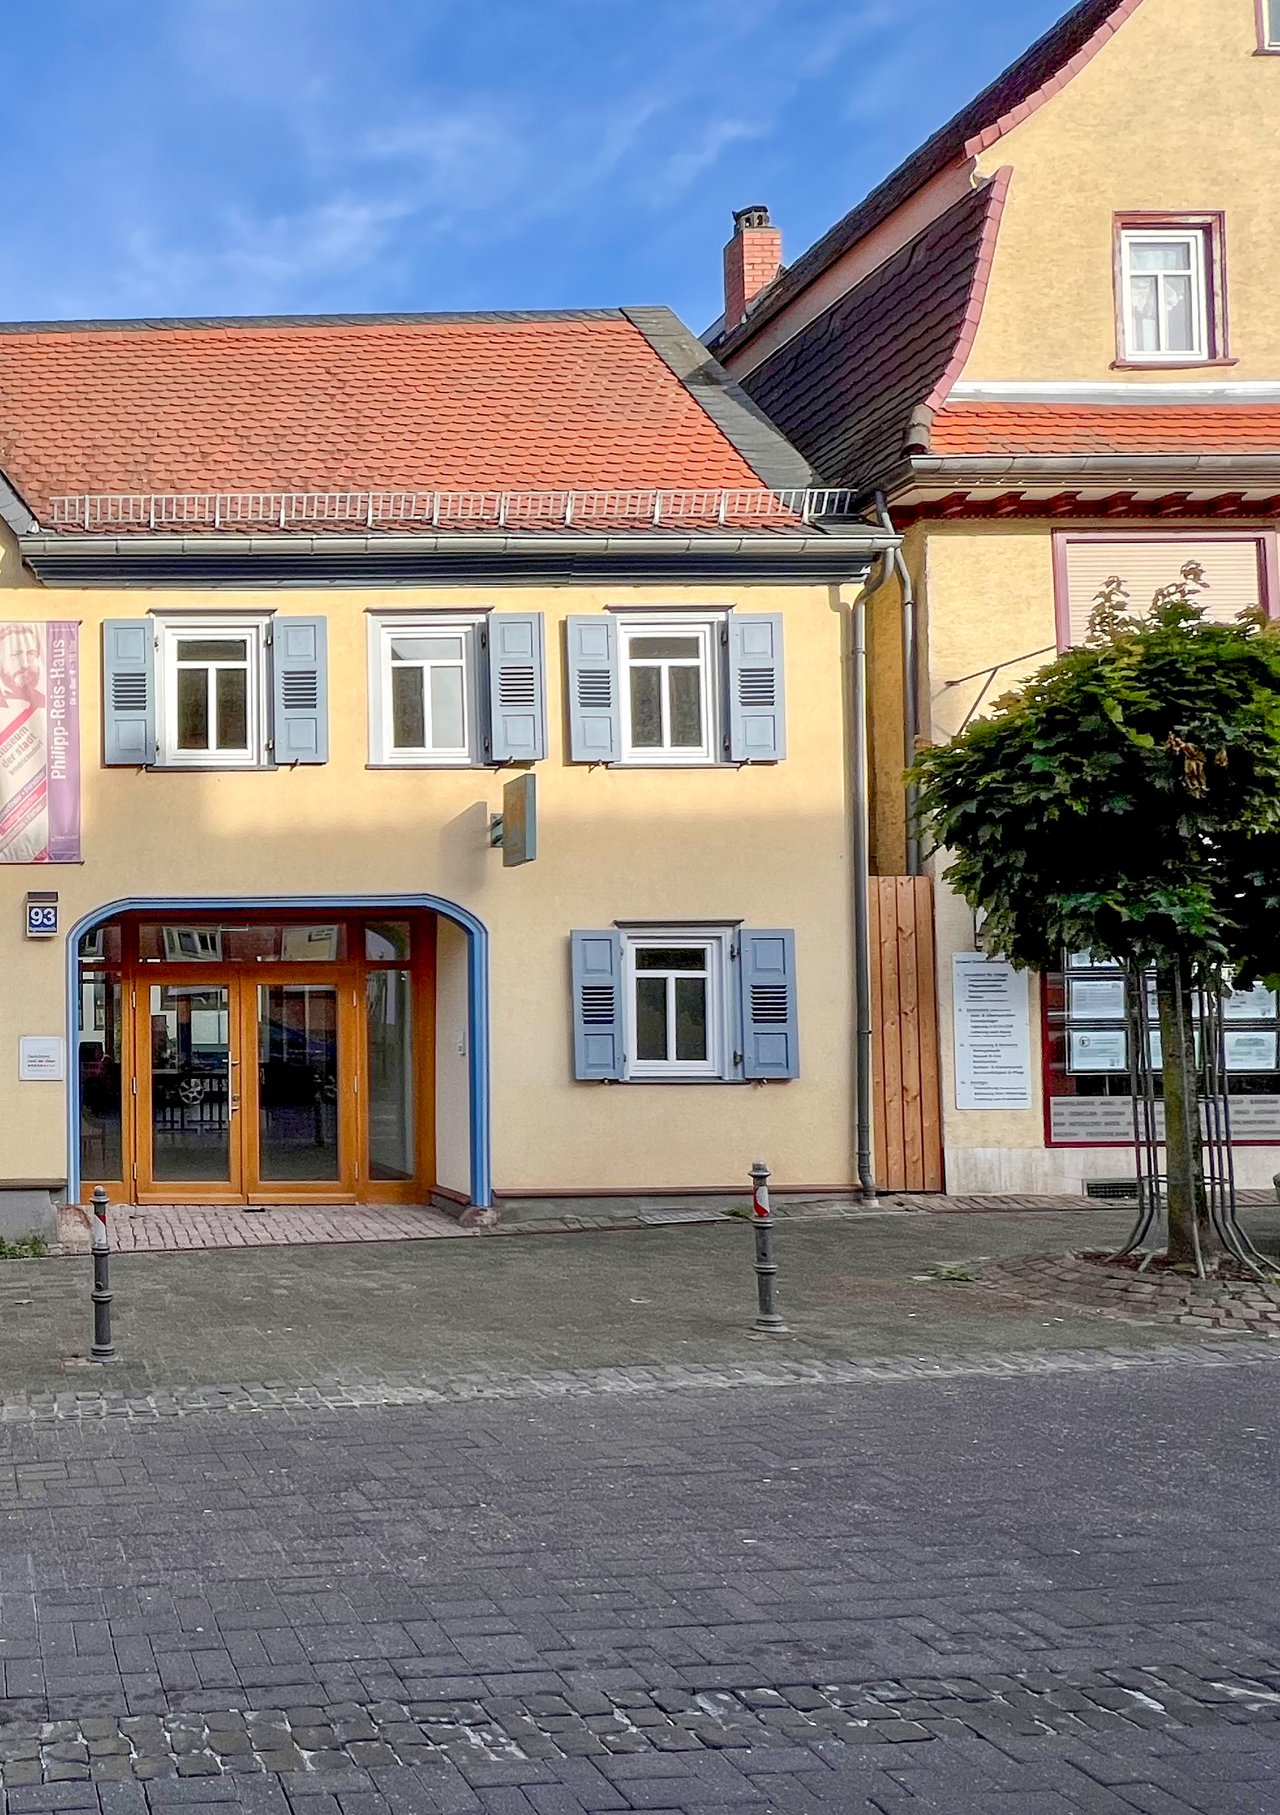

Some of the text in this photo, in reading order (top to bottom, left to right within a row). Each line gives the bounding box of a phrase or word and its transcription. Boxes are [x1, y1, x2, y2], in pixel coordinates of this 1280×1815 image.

[50, 640, 69, 780] Philipp-Reis-Haus
[1, 733, 38, 769] der stadt
[30, 907, 56, 926] 93
